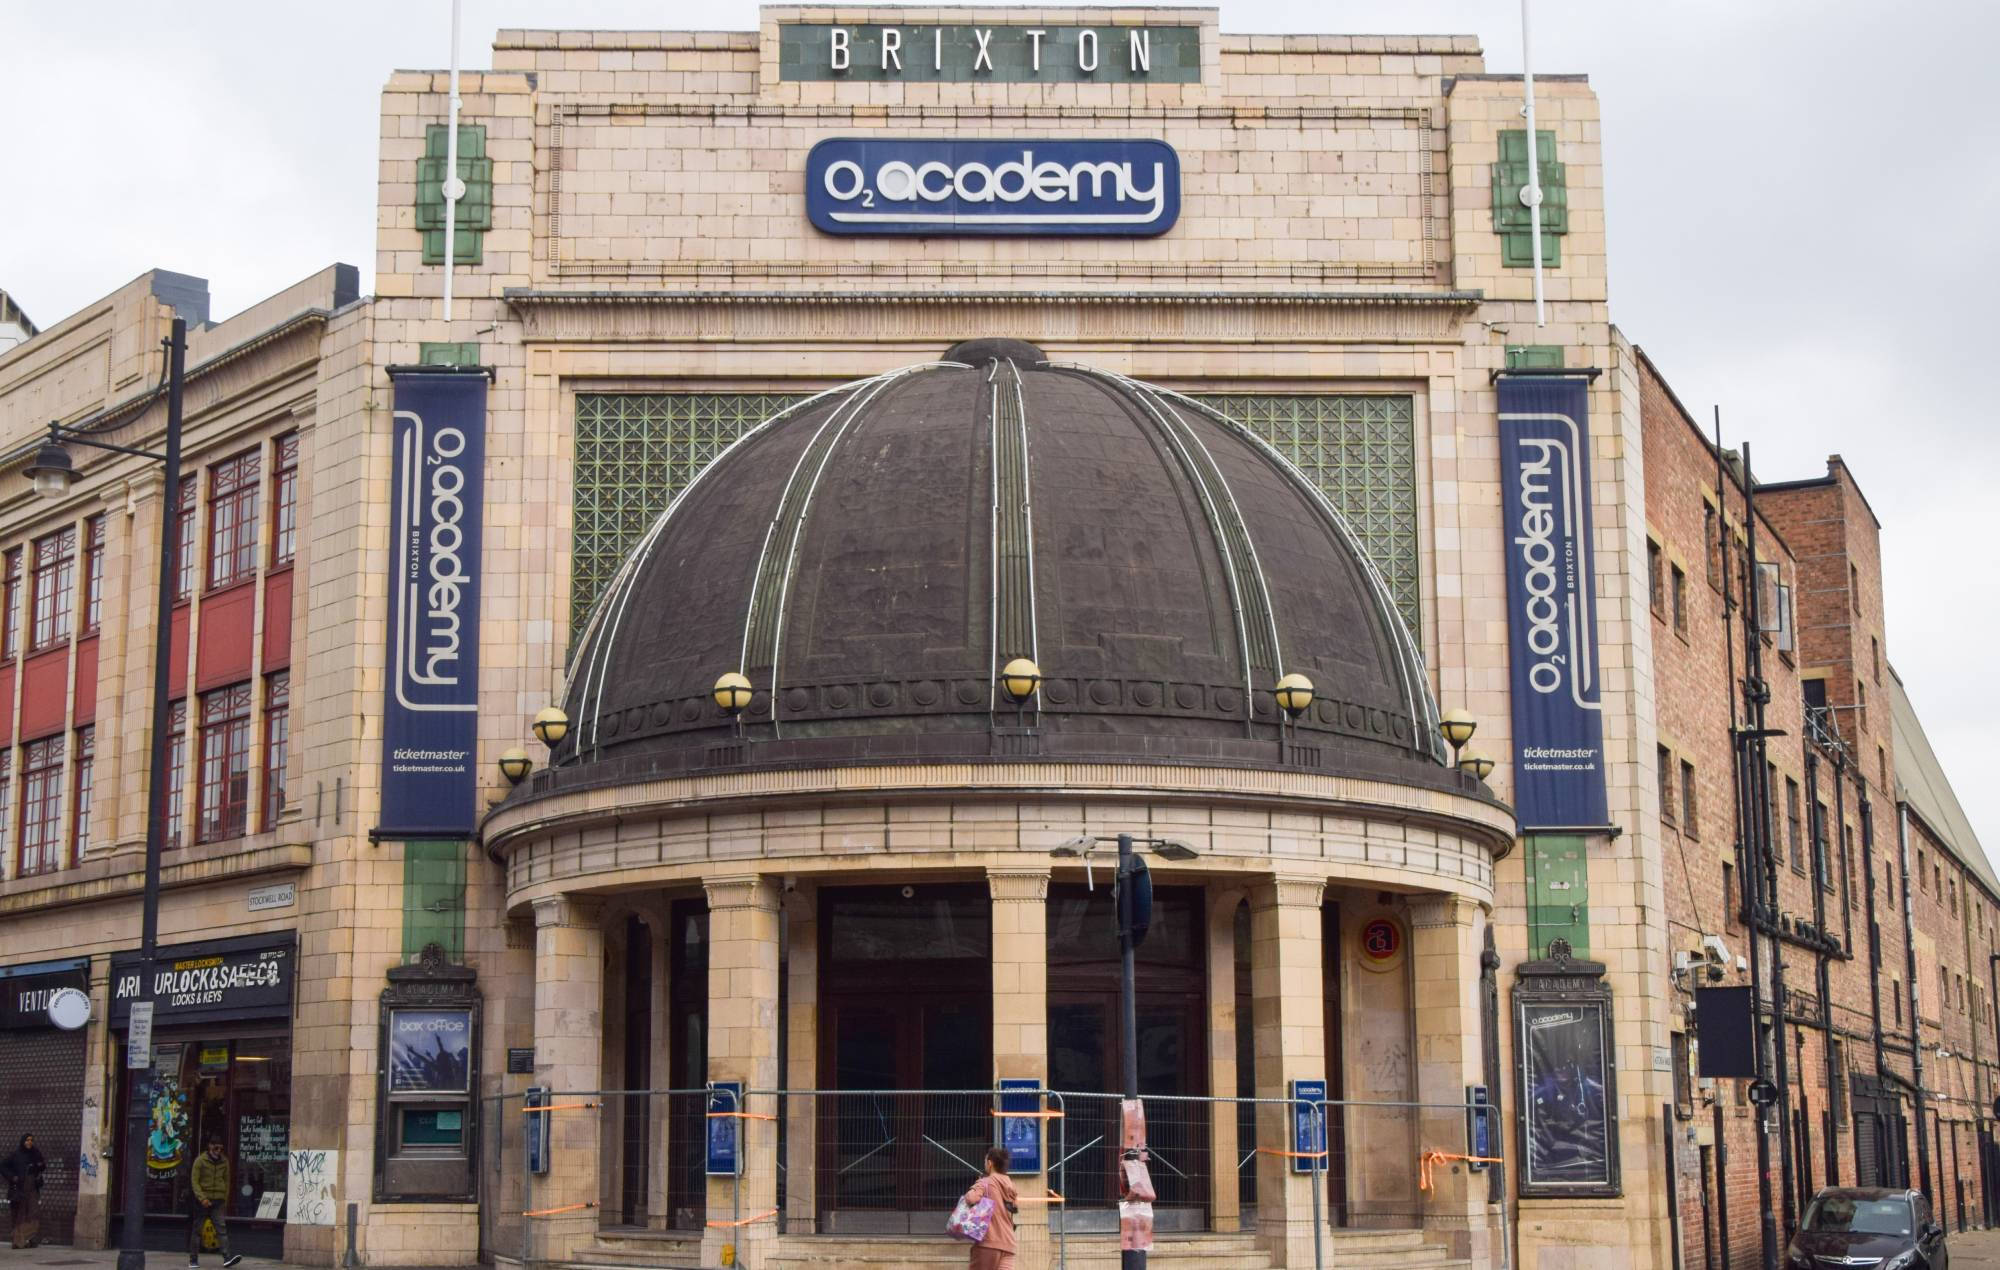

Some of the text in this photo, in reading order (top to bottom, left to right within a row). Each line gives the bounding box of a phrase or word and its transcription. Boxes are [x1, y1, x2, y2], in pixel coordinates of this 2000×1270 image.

[830, 28, 1150, 71] BRIXTON
[411, 530, 420, 579] BRIXTON
[1566, 541, 1574, 589] BRIXTON
[393, 748, 466, 760] ticketmaster
[1523, 747, 1594, 758] ticketmaster
[393, 764, 465, 773] ticketmaster.co.uk
[1524, 763, 1596, 771] ticketmaster.co.uk
[250, 895, 277, 906] STOCKWELL
[278, 891, 293, 901] ROAD
[172, 990, 223, 1007] LOCKS & KEYS
[400, 1018, 464, 1032] box office
